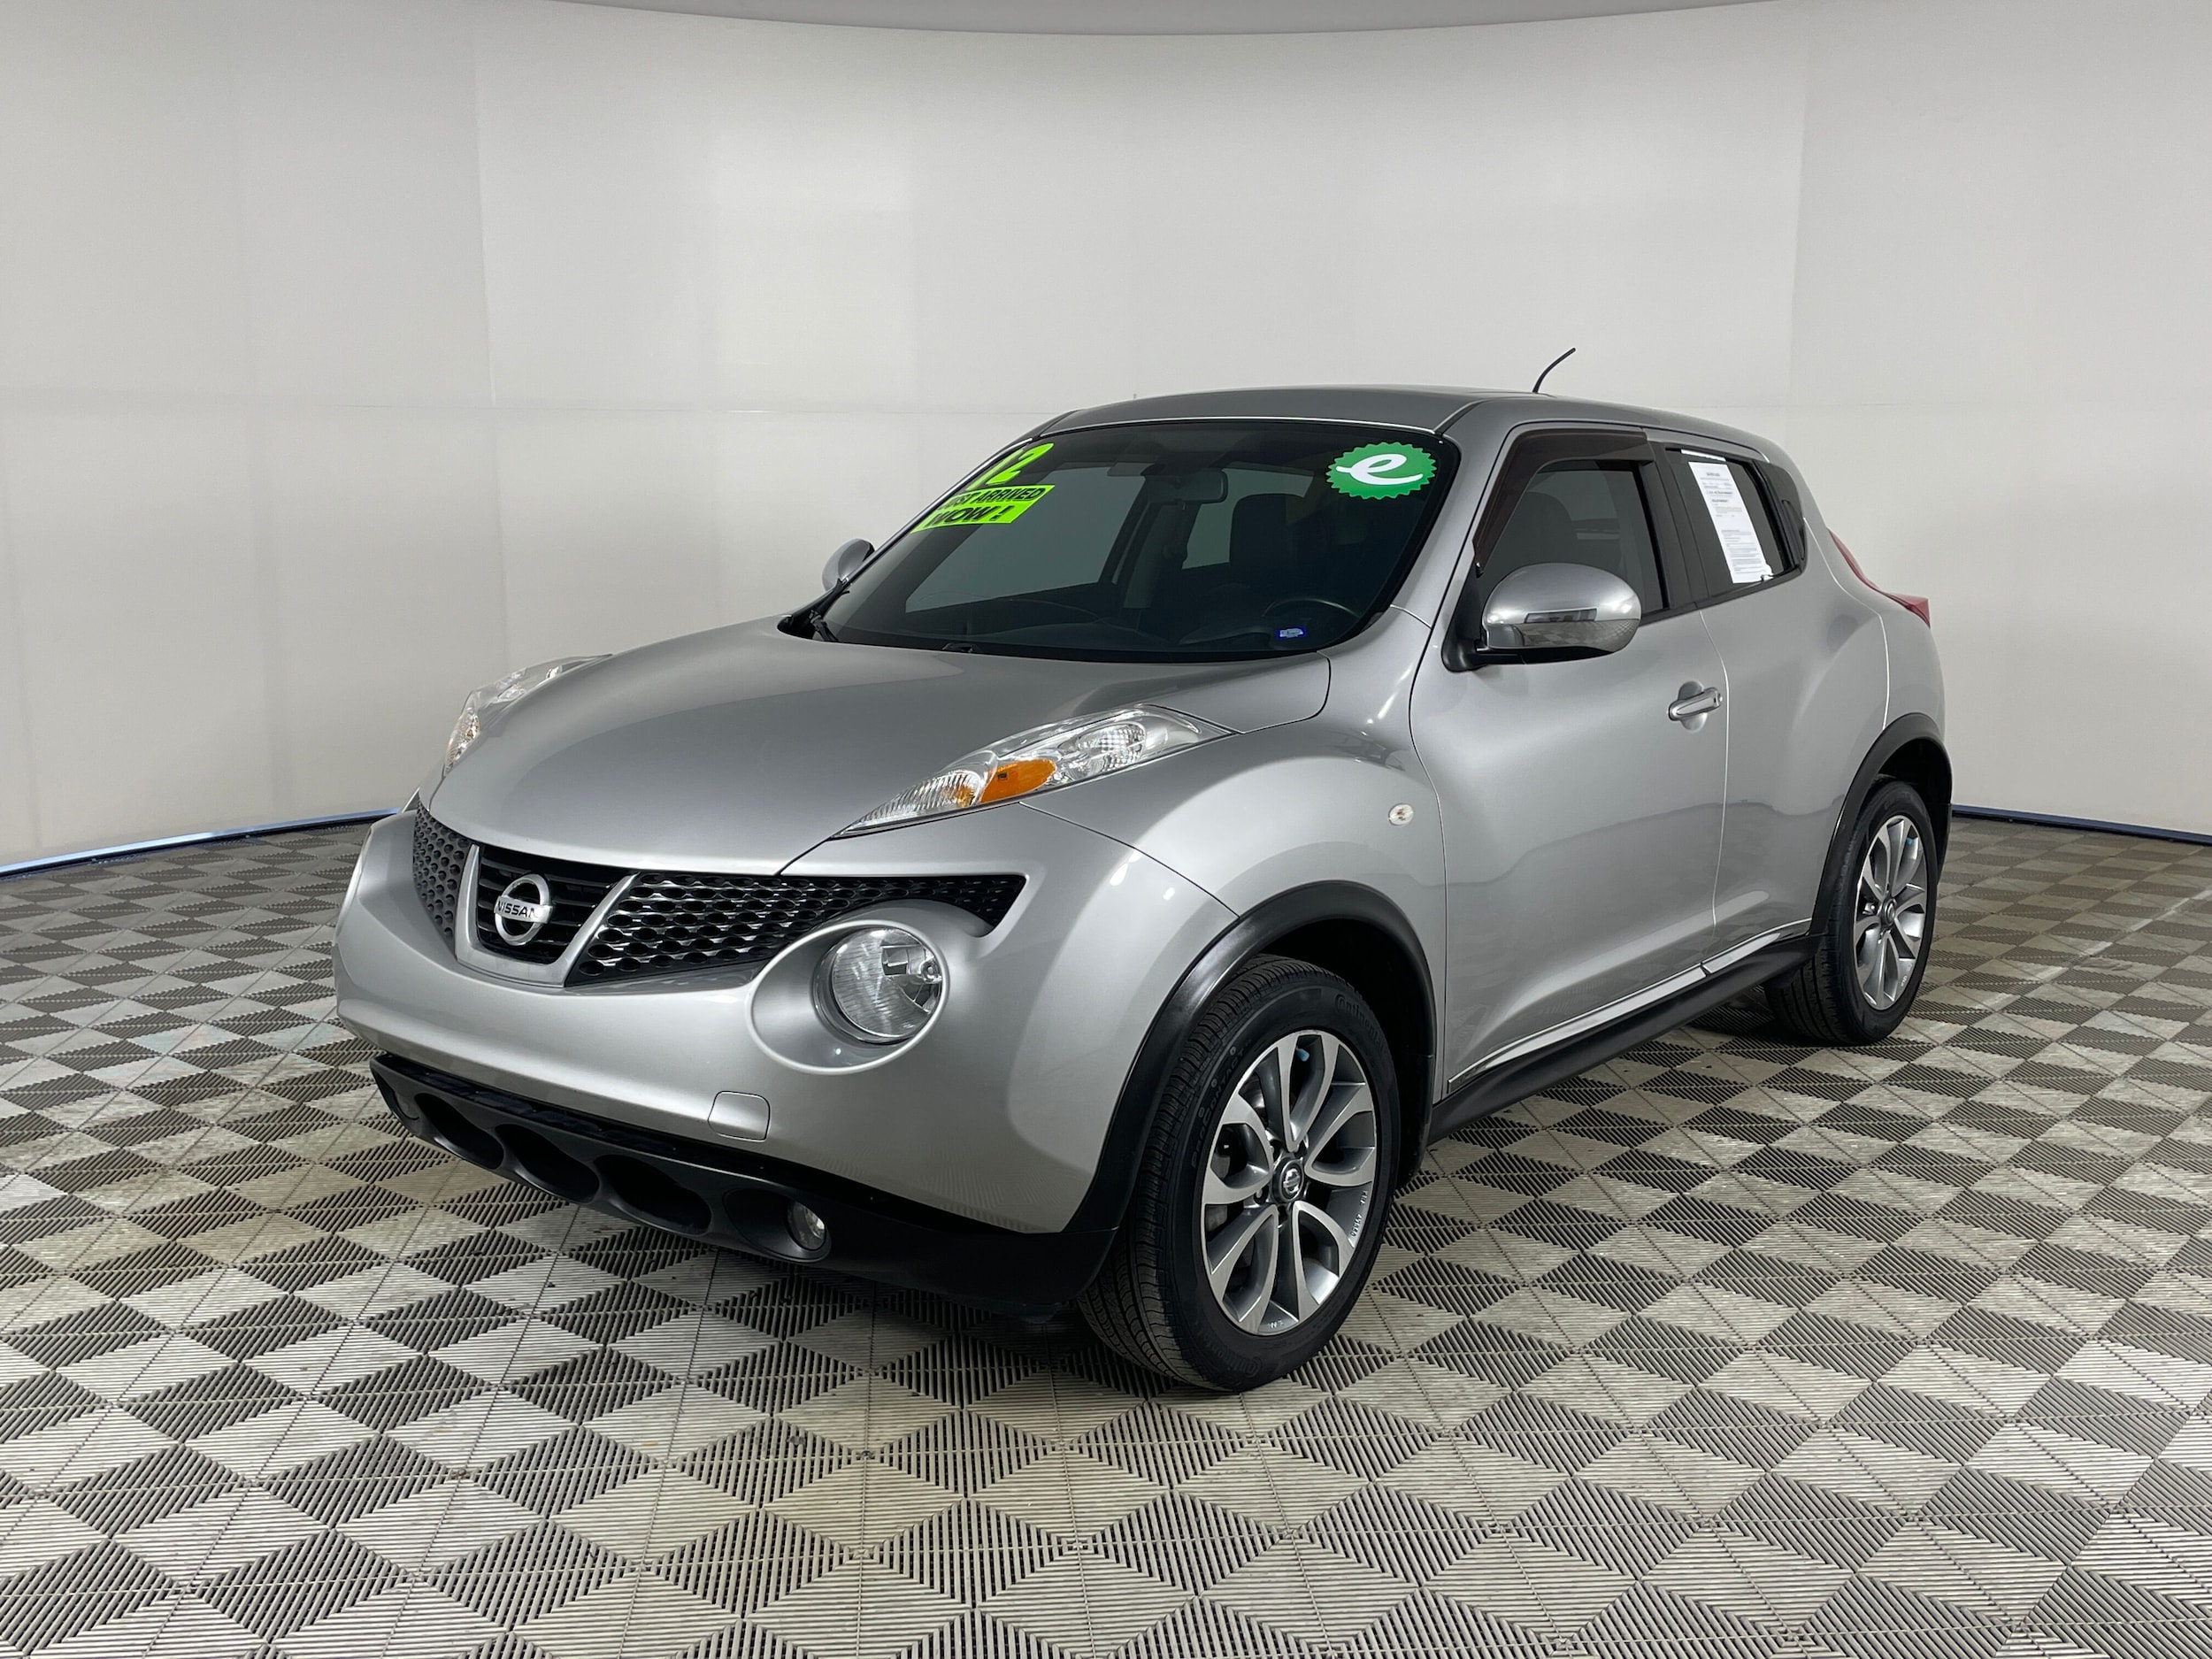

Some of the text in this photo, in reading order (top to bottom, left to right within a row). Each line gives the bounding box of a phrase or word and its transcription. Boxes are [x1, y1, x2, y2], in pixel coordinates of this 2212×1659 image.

[965, 442, 1054, 491] 12
[1335, 453, 1424, 486] e
[970, 488, 1046, 505] ARRIVED
